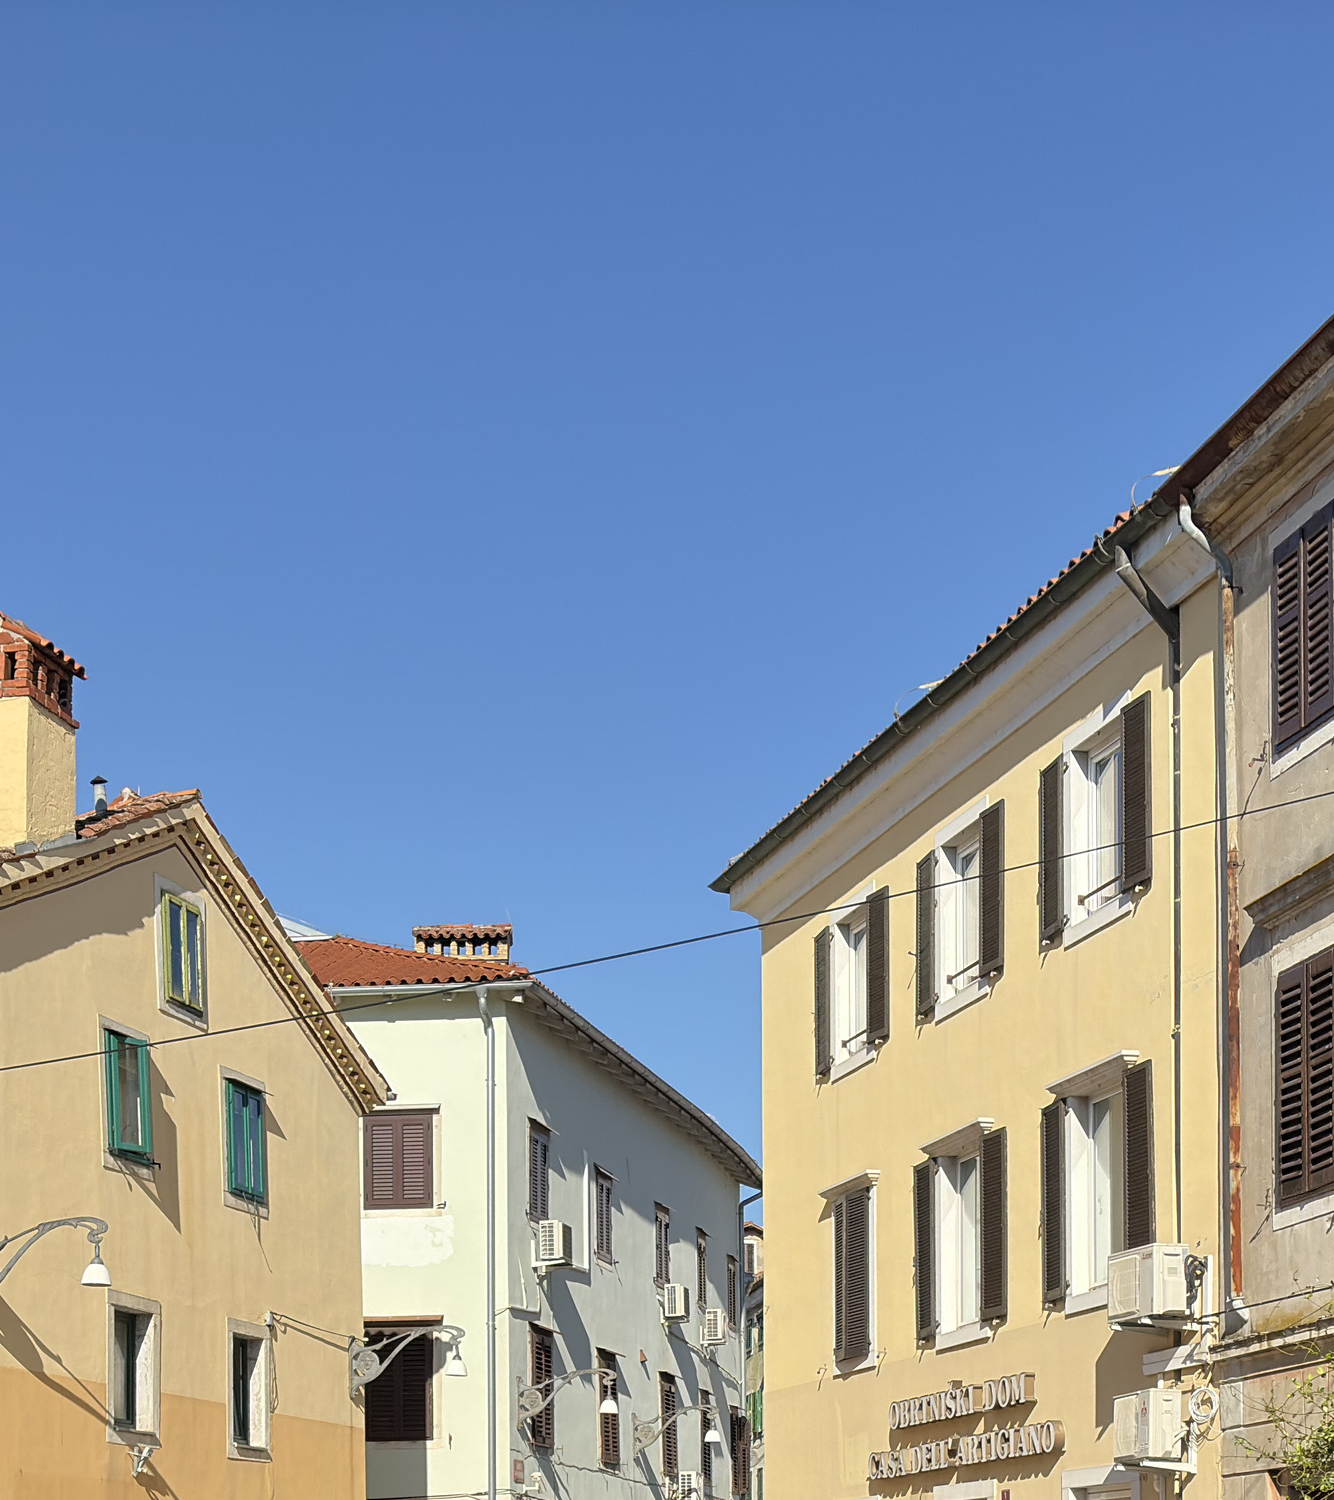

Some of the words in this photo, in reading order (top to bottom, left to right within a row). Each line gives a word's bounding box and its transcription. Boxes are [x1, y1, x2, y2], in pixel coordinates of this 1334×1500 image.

[889, 1380, 975, 1430] OBRTNIŠKI
[983, 1373, 1027, 1411] DOM
[868, 1451, 907, 1480] CASA
